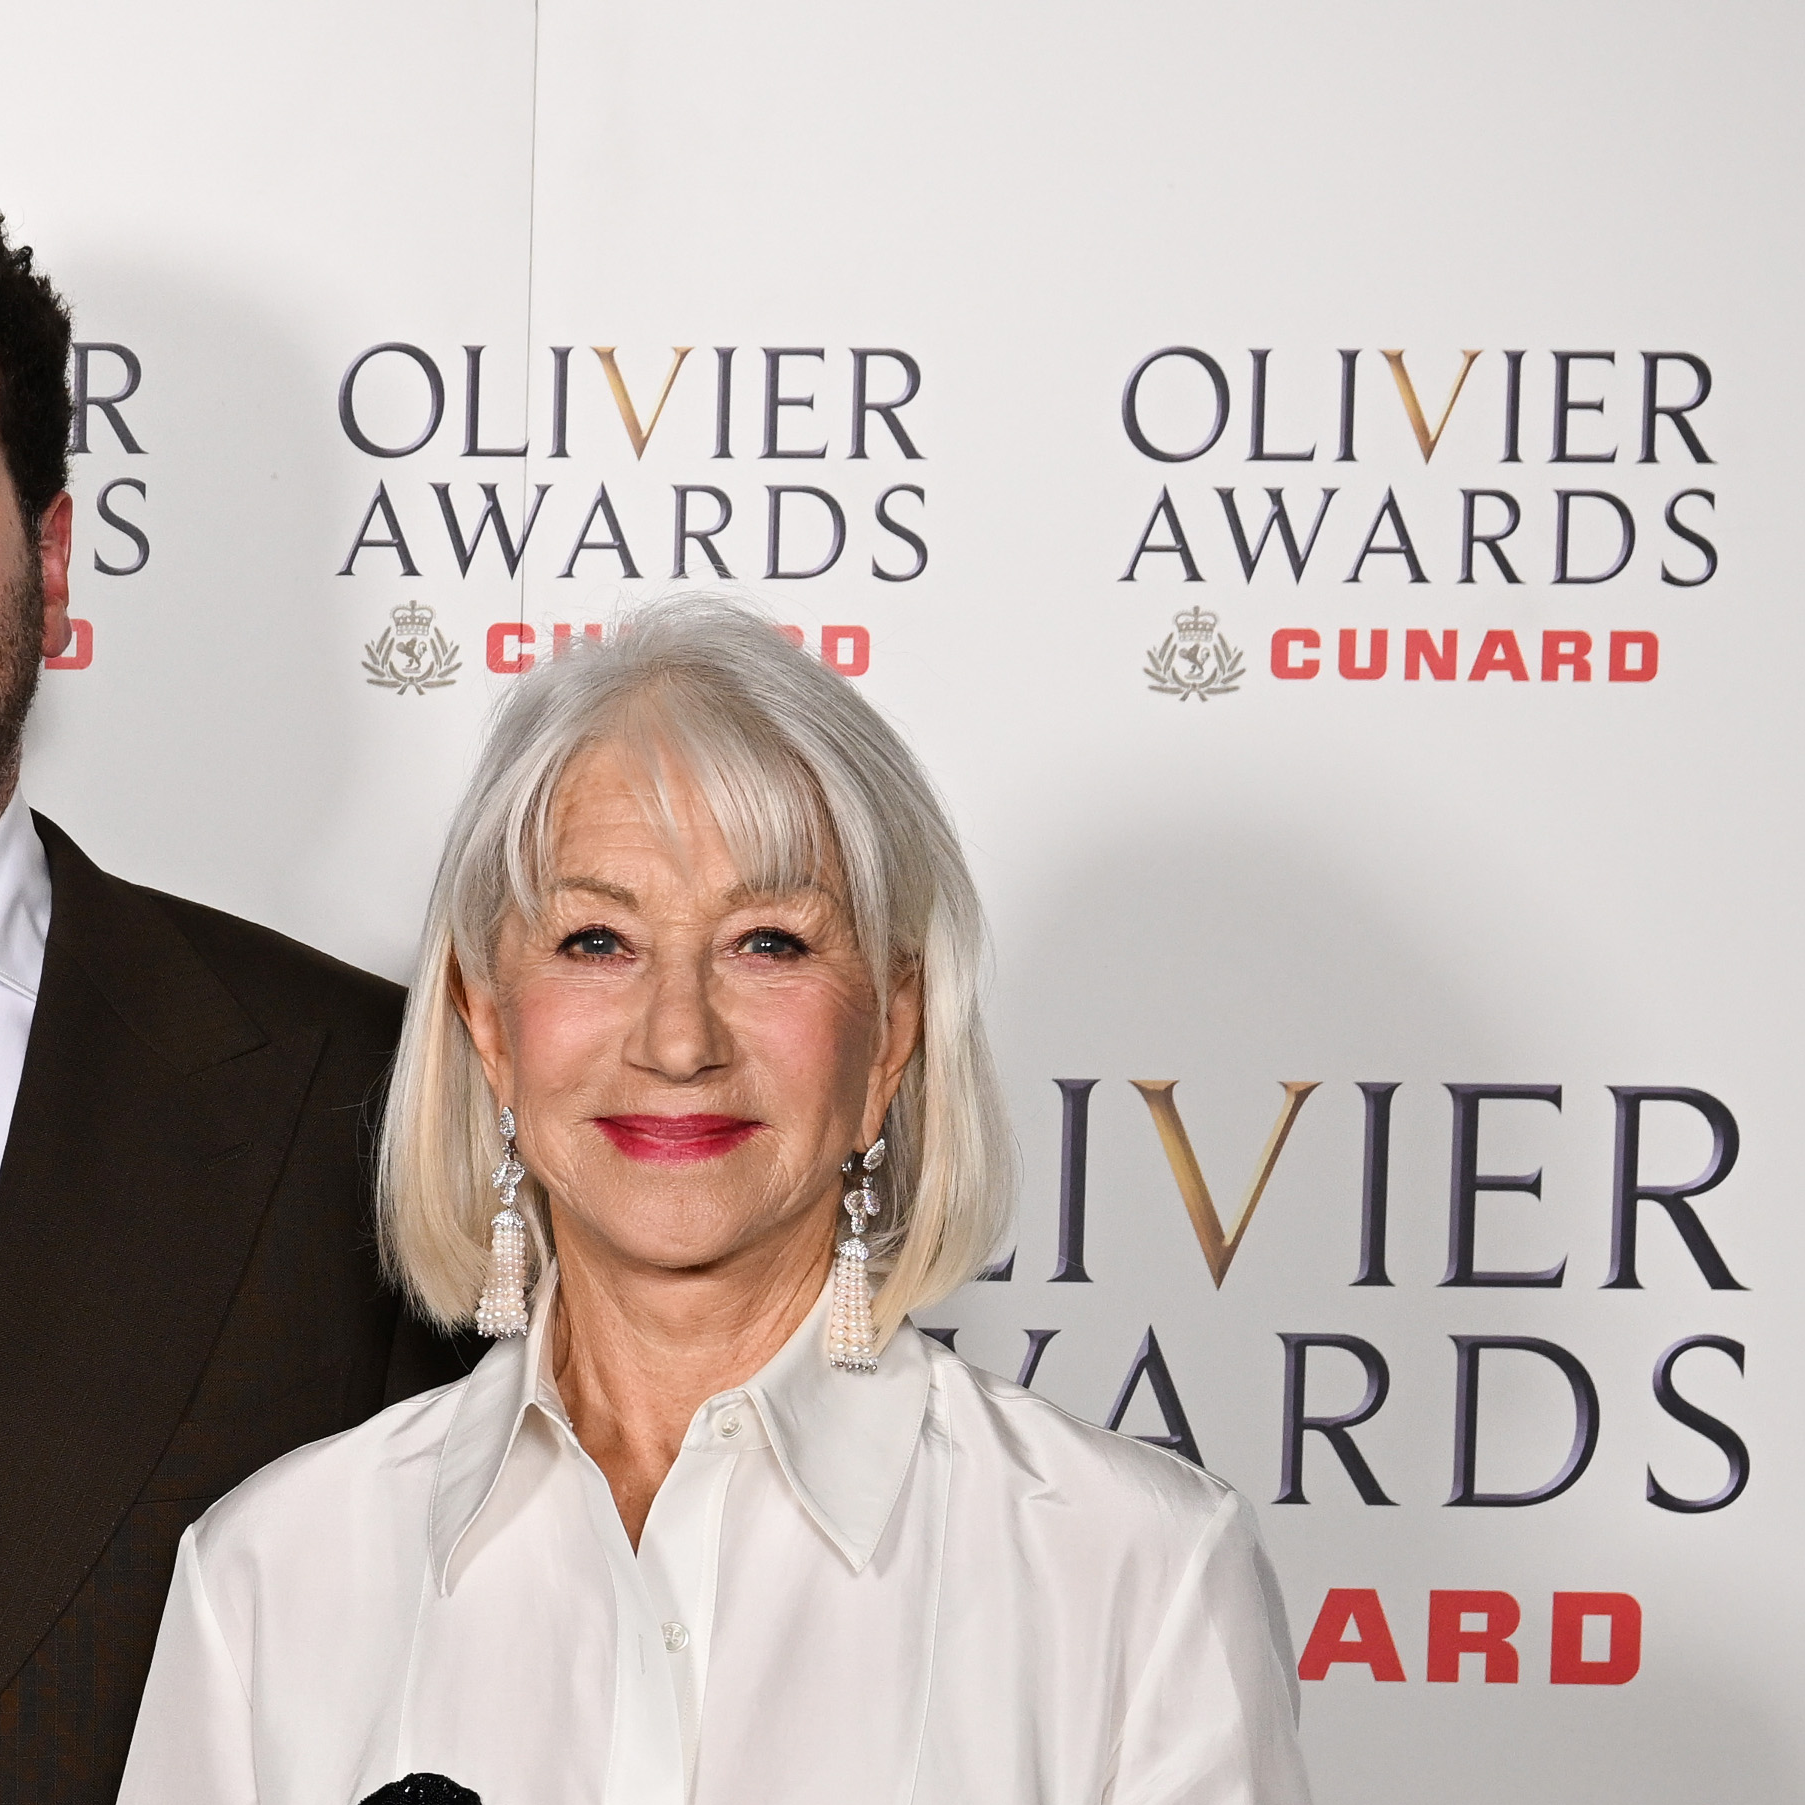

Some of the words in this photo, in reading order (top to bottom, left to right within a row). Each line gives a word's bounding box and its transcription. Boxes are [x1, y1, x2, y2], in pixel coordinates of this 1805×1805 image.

[337, 341, 927, 462] OLIVIER
[1121, 345, 1718, 466] OLIVIER
[335, 478, 929, 583] AWARDS
[1117, 483, 1719, 589] AWARDS
[1270, 627, 1660, 684] CUNARD
[975, 1078, 1753, 1292] IVIER
[930, 1324, 1751, 1514] ARDS
[1298, 1588, 1643, 1686] ARD
